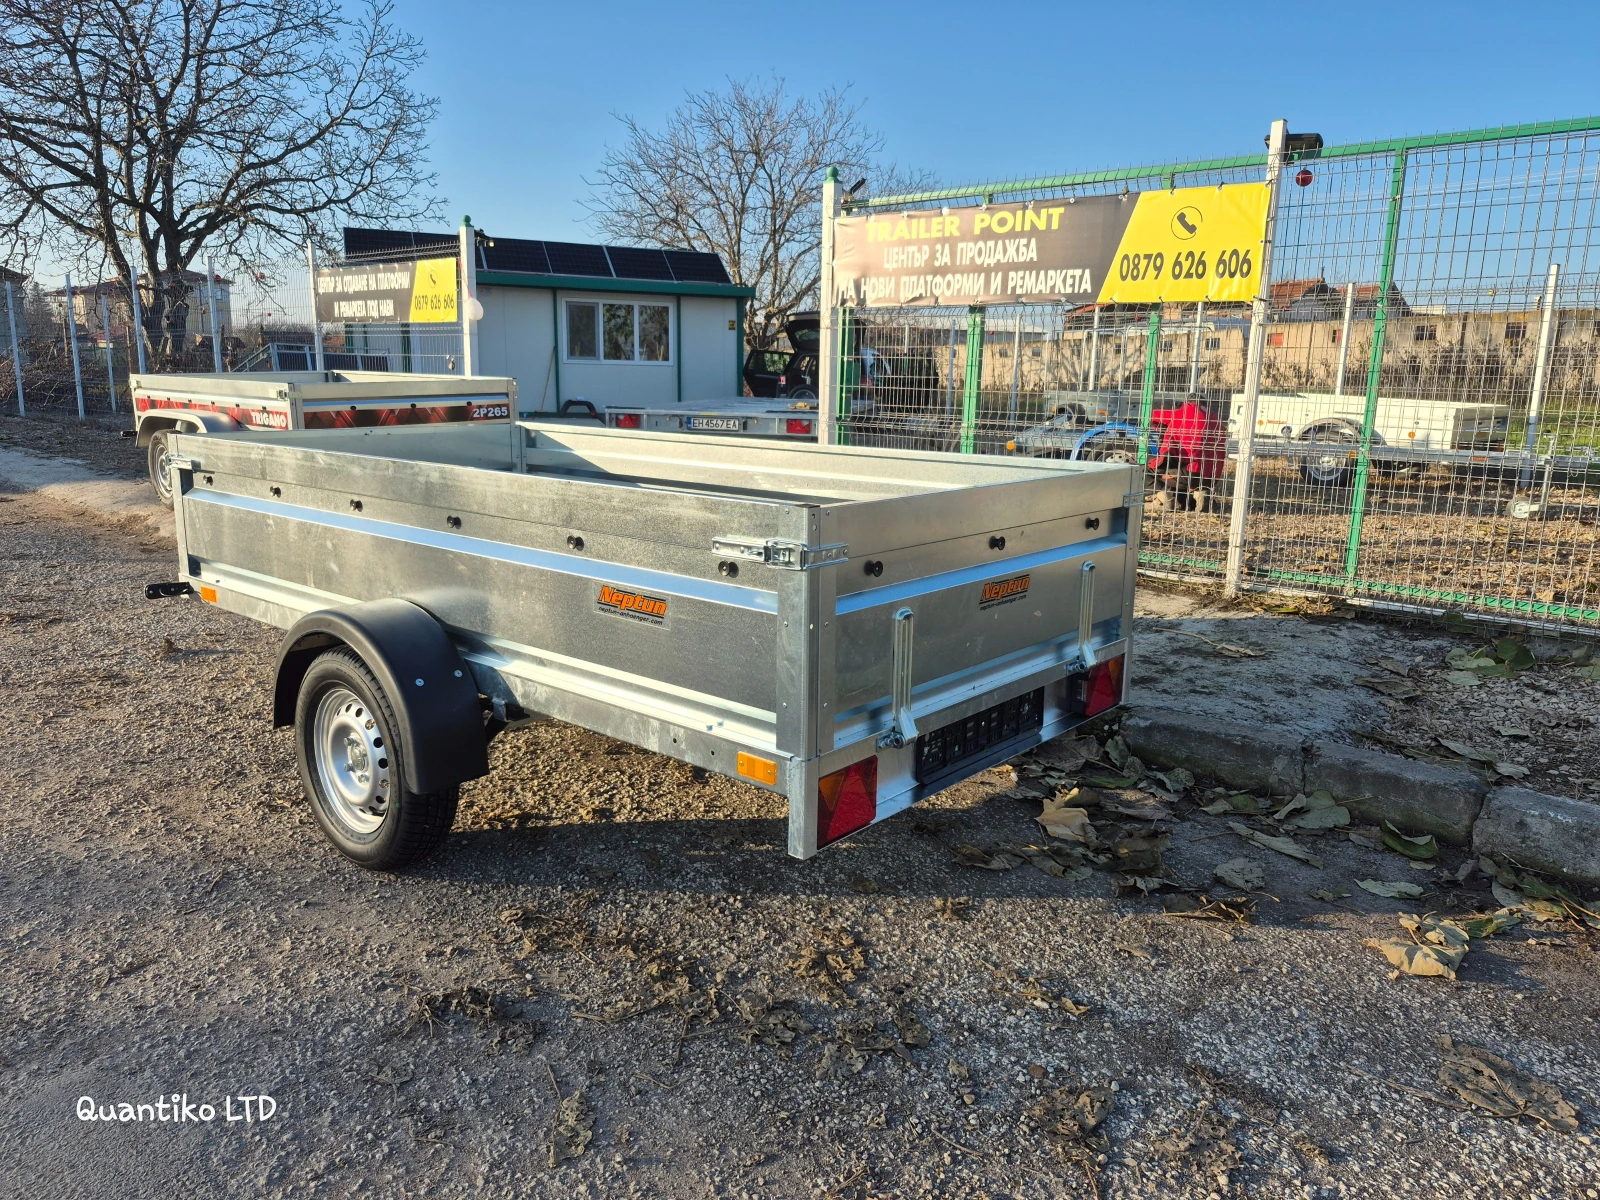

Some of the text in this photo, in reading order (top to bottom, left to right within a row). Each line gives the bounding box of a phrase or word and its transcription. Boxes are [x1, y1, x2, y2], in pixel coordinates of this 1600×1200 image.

[864, 207, 1065, 243] TRAILER POINT
[883, 237, 1038, 272] ЦЕНТЪР ЗА ПРОДАЖБА
[1119, 248, 1252, 282] 0879 626 606
[368, 273, 377, 291] НА
[860, 276, 896, 299] НОВИ
[900, 272, 986, 301] ПЛАТФОРМИ
[990, 271, 1002, 296] И
[1006, 268, 1092, 295] РЕМАРКЕТА
[414, 293, 454, 310] 0879 626 606
[251, 410, 288, 428] TRIGANO
[472, 406, 508, 418] 2P265
[598, 585, 668, 616] Neptun
[980, 576, 1031, 601] Neptun
[598, 606, 663, 626] neptun-anhaenger.com
